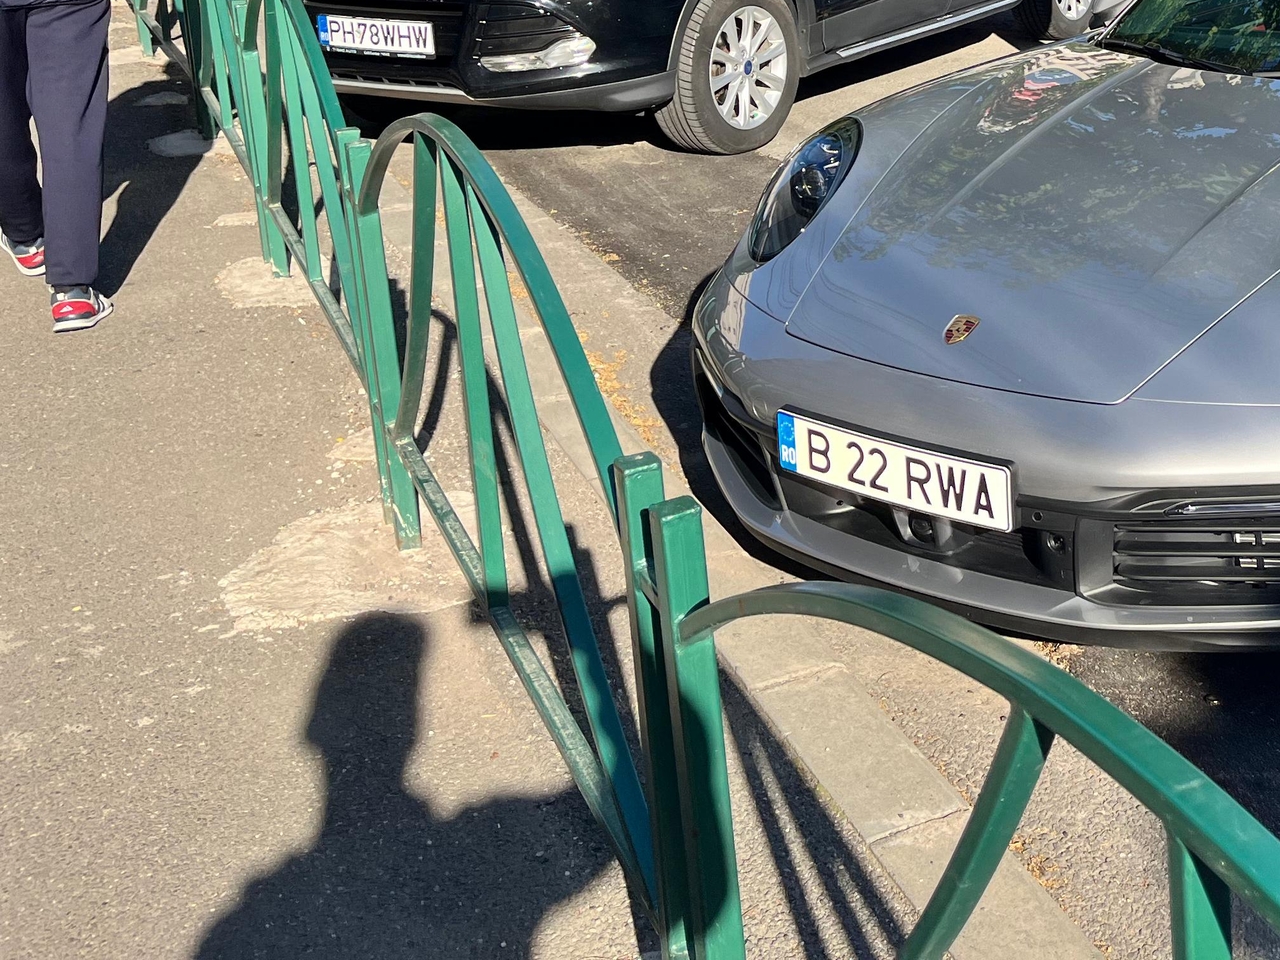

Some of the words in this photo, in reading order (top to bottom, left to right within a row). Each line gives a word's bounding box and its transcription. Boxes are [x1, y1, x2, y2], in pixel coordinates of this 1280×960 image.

[781, 444, 796, 465] RO
[807, 427, 831, 474] B
[846, 441, 889, 493] 22
[905, 455, 995, 520] RWA
